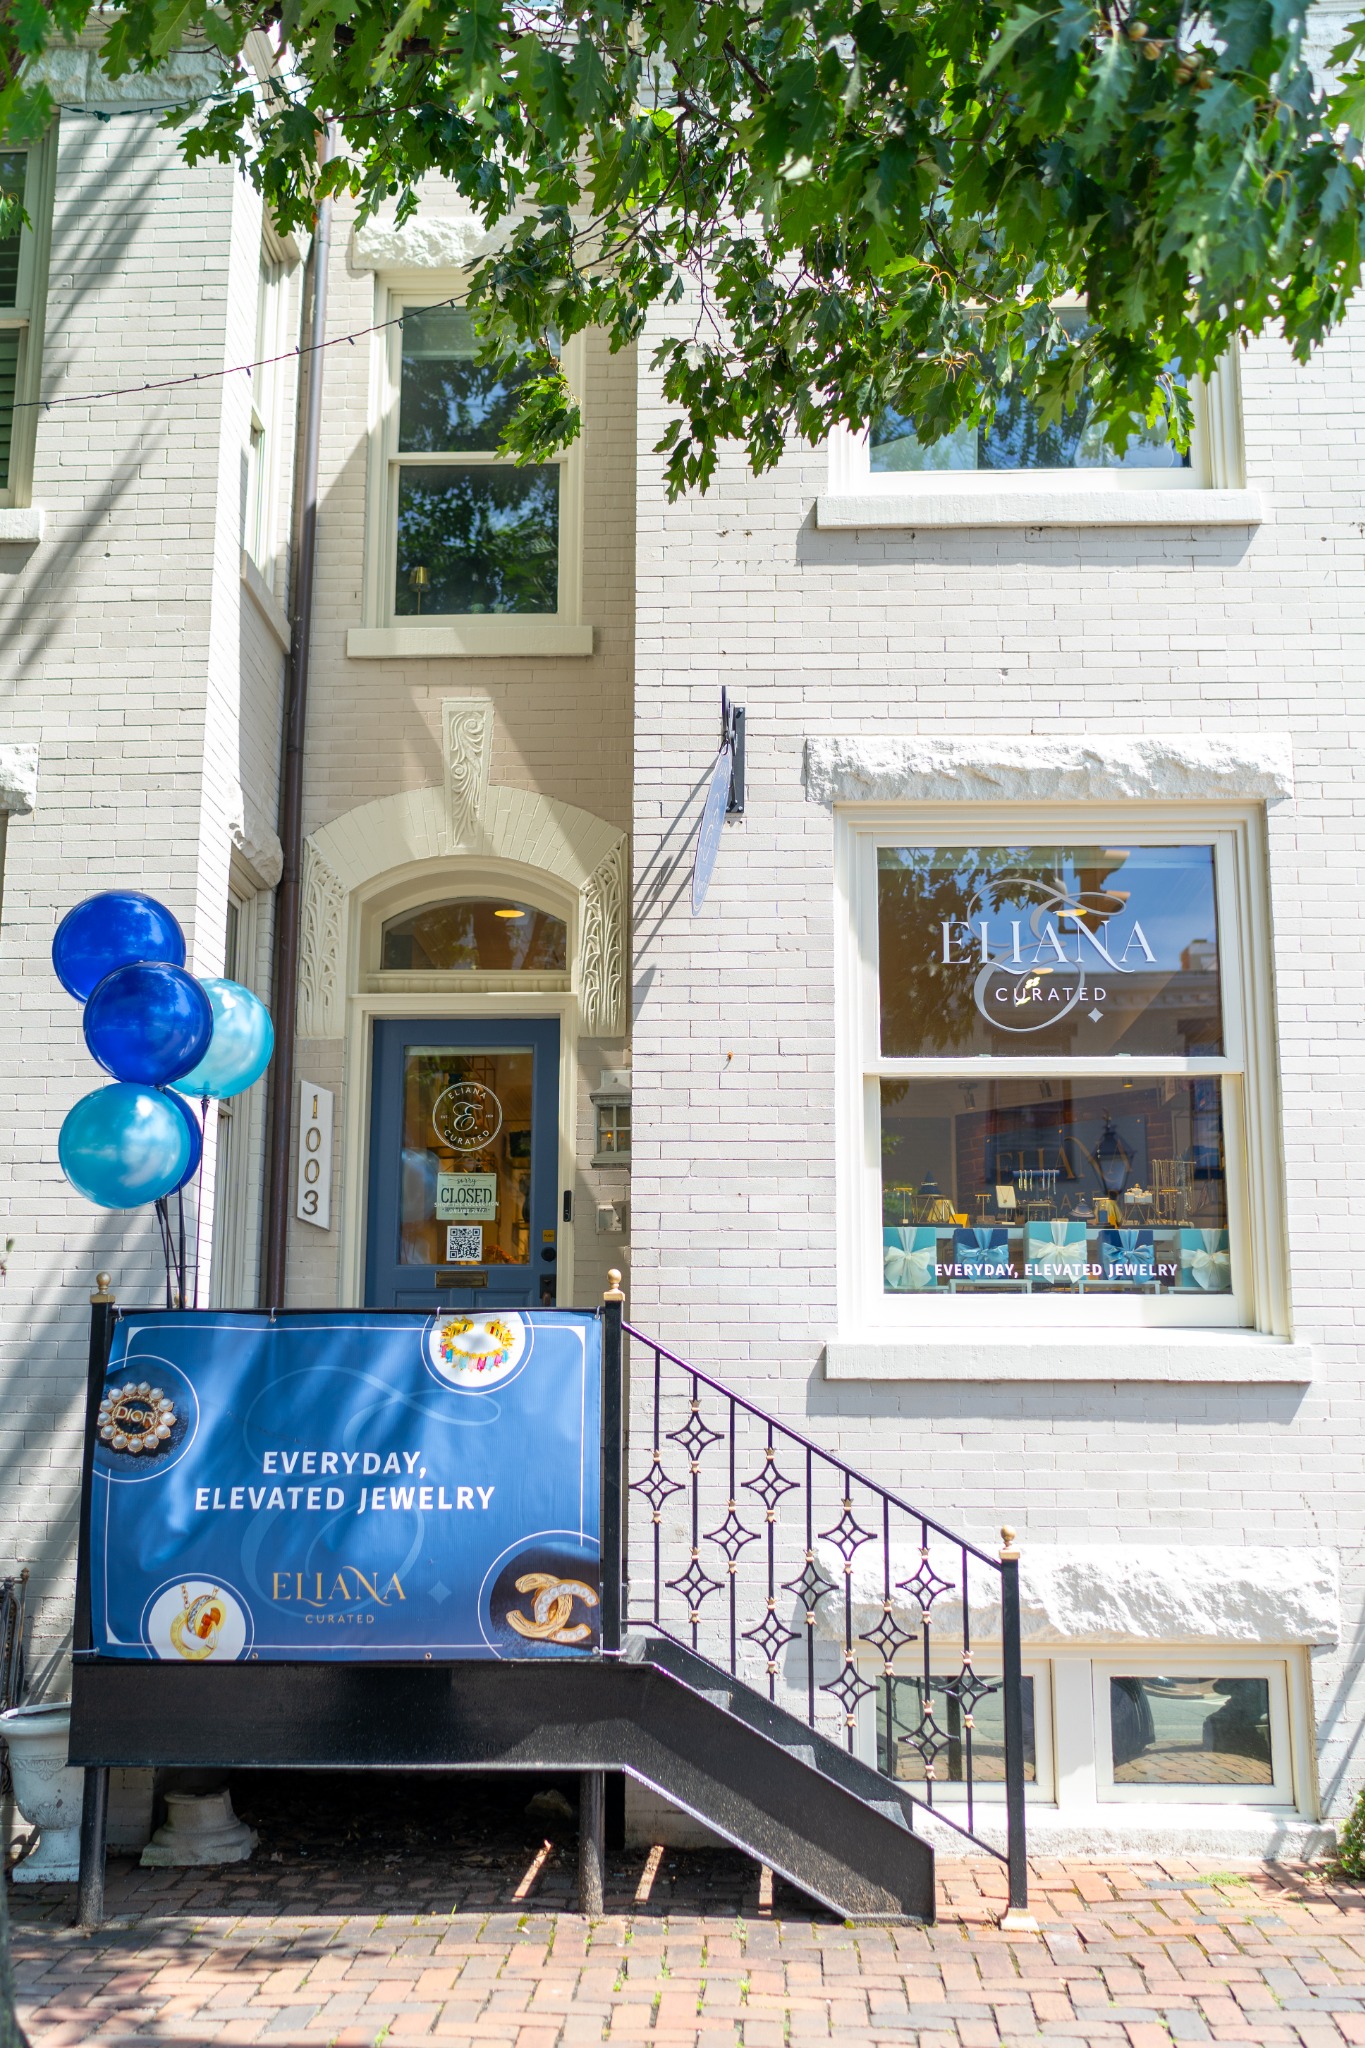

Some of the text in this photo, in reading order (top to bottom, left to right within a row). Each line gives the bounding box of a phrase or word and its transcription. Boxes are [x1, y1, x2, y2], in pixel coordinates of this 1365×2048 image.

[941, 910, 1157, 975] ELIANA
[995, 987, 1107, 1002] CURATED
[447, 1087, 487, 1100] ELIANA
[444, 1129, 490, 1146] CURATED
[302, 1094, 321, 1216] 1003
[441, 1187, 492, 1203] CLOSED
[934, 1263, 1178, 1279] EVERYDAY, ELEVATED JEWELRY
[115, 1405, 155, 1427] DIOR
[262, 1451, 427, 1479] EVERYDAY,
[195, 1486, 496, 1515] ELEVATED JEWELRY
[272, 1565, 407, 1608] ELIANA
[304, 1613, 375, 1624] CURATED
